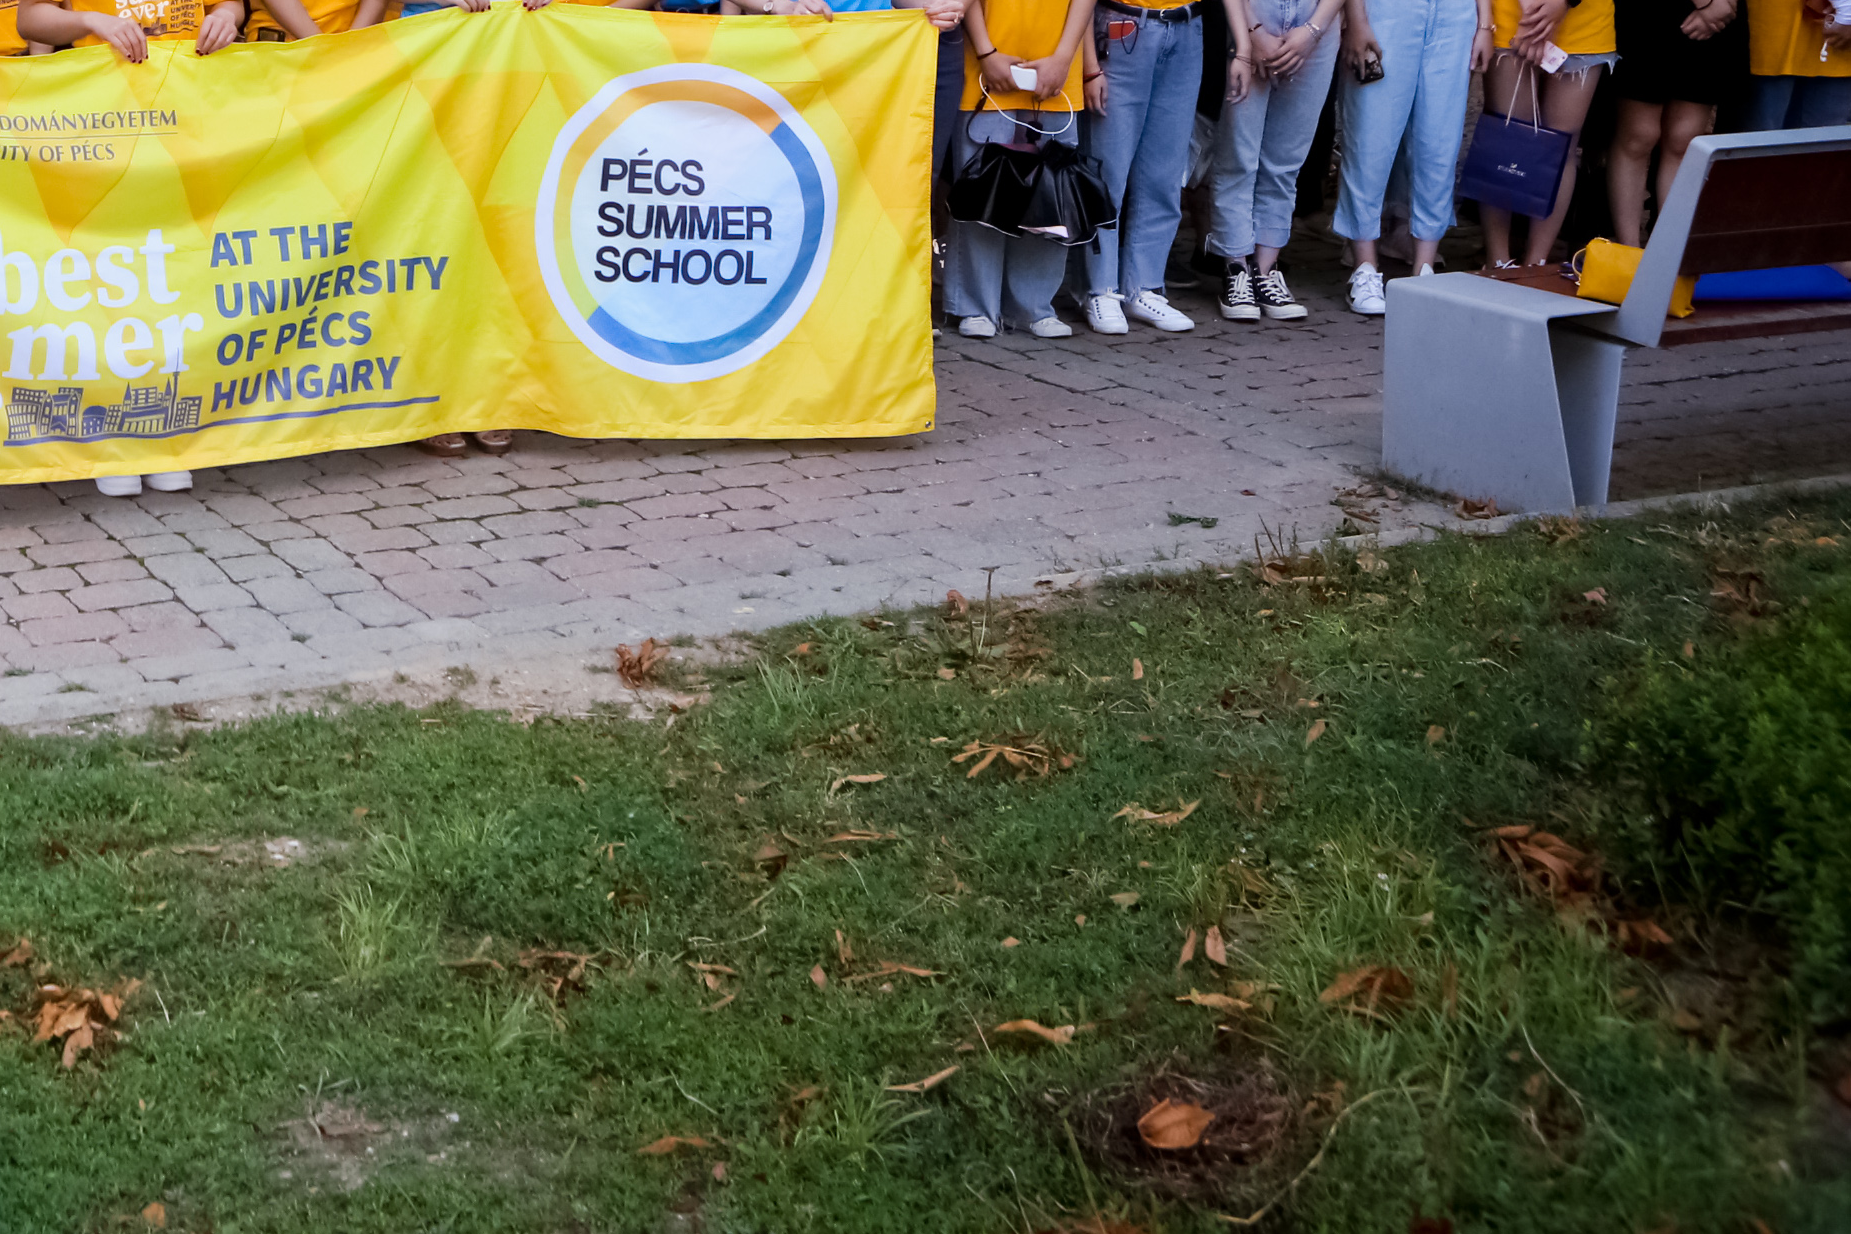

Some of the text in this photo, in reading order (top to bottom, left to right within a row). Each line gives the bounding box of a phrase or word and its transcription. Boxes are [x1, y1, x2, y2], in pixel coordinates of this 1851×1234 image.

[38, 144, 65, 162] OF
[71, 140, 115, 161] PÉCS
[600, 147, 706, 196] PÉCS
[210, 221, 353, 267] AT THE
[596, 201, 773, 241] SUMMER
[214, 255, 449, 318] UNIVERSITY
[594, 246, 768, 286] SCHOOL
[216, 305, 372, 366] OF PÉCS
[210, 356, 401, 413] HUNGARY
